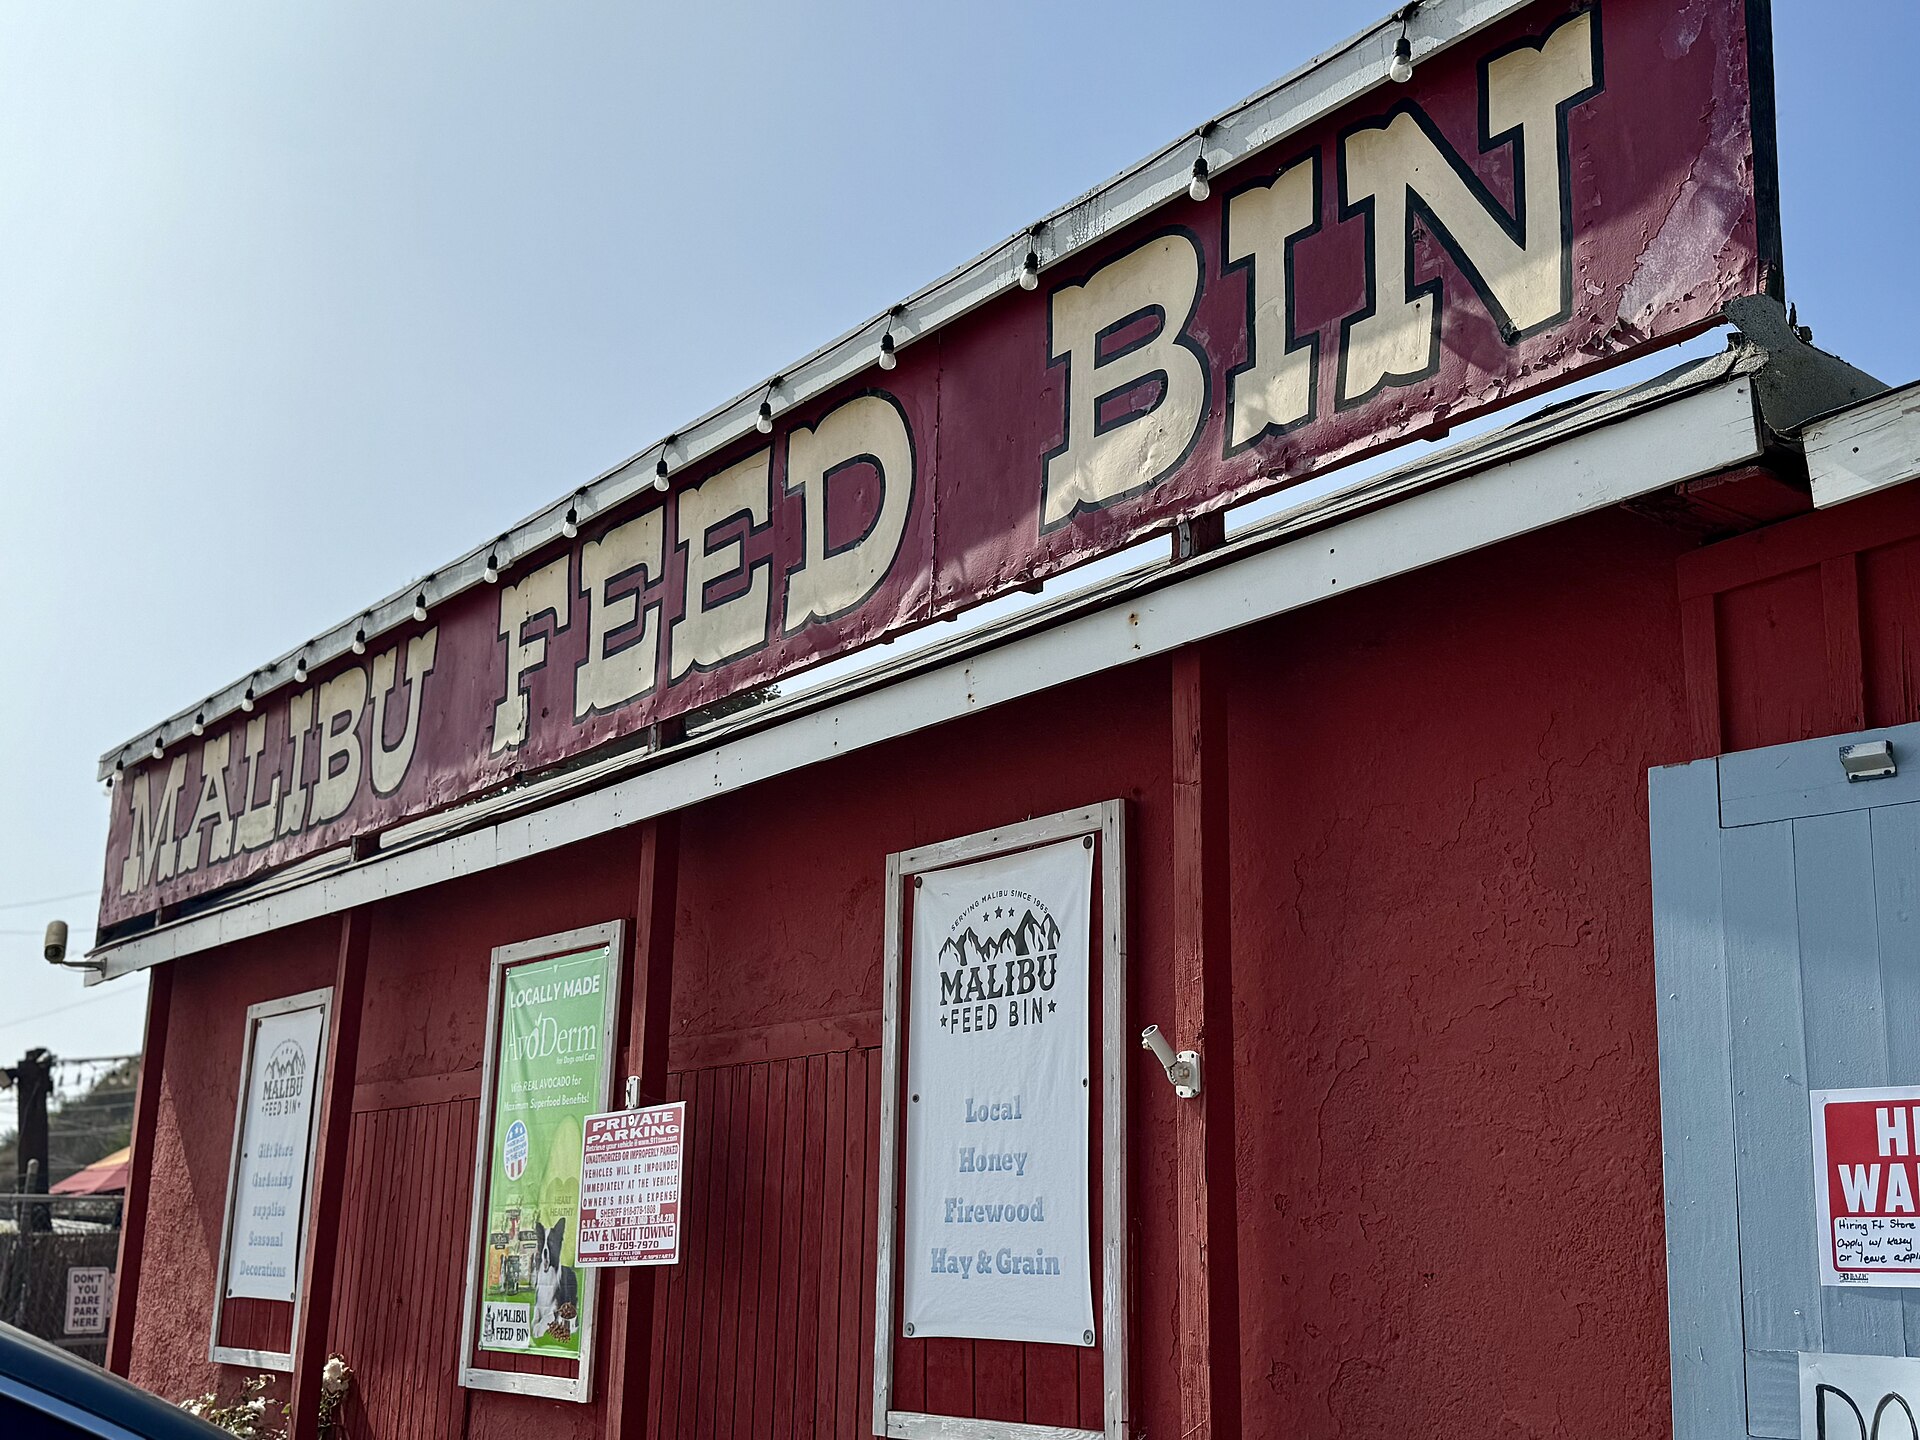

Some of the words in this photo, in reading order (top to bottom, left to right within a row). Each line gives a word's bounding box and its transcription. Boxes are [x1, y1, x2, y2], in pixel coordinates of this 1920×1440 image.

[120, 625, 439, 897] MALIBU
[490, 387, 916, 758] FEED
[1039, 3, 1604, 535] BIN
[951, 900, 980, 931] SERVING
[981, 890, 1008, 903] MALIBU
[1011, 889, 1032, 901] SINCE
[1033, 897, 1049, 914] 1965
[940, 953, 1057, 1006] MALIBU
[510, 981, 560, 1009] LOCALLY
[563, 974, 600, 999] MADE
[951, 1003, 997, 1034] FEED
[1009, 996, 1043, 1027] BIN
[262, 1076, 304, 1101] MALIBU
[522, 1079, 538, 1092] REAL
[540, 1075, 570, 1089] AVOCADO
[572, 1074, 581, 1085] for
[530, 1095, 560, 1111] Superfood
[562, 1091, 589, 1106] Benefits!
[965, 1095, 1022, 1123] Local
[586, 1125, 679, 1145] PARKING
[258, 1142, 272, 1158] Gift
[585, 1152, 621, 1165] UNAUTHORIZED
[622, 1151, 630, 1160] OR
[630, 1147, 659, 1160] IMPROPERLY
[660, 1145, 678, 1156] PARKED
[585, 1167, 613, 1179] VEHICLES
[617, 1165, 630, 1176] WILL
[634, 1164, 641, 1174] BE
[645, 1160, 677, 1173] IMPOUNDED
[959, 1147, 1028, 1176] Honey
[252, 1171, 293, 1189] Gardening
[584, 1180, 624, 1194] IMMEDIATELY
[628, 1179, 635, 1189] AT
[639, 1178, 649, 1188] THE
[653, 1175, 677, 1187] VEHICLE
[1837, 1162, 1920, 1213] WA
[554, 1195, 572, 1205] HEART
[583, 1196, 614, 1208] OWNER'S
[618, 1194, 634, 1205] RISK
[647, 1190, 677, 1202] EXPENSE
[549, 1207, 574, 1217] HEALTHY
[600, 1207, 622, 1218] SHERIFF
[944, 1196, 1044, 1223] Firewood
[582, 1230, 600, 1242] DAY
[602, 1229, 608, 1241] &
[610, 1227, 637, 1241] NIGHT
[640, 1225, 674, 1239] TOWING
[1839, 1217, 1868, 1236] Hiring
[1890, 1218, 1916, 1229] Store
[248, 1231, 283, 1247] Seasonal
[599, 1240, 659, 1251] 818-709-7970
[1869, 1237, 1882, 1248] w/
[240, 1260, 286, 1278] Decorations
[931, 1248, 972, 1279] Hay
[976, 1249, 992, 1274] &
[996, 1248, 1060, 1275] Grain
[73, 1274, 103, 1283] DON'T
[77, 1285, 98, 1294] YOU
[74, 1296, 100, 1305] DARE
[73, 1306, 99, 1316] PARK
[496, 1308, 527, 1323] MALIBU
[72, 1317, 98, 1327] HERE
[495, 1327, 514, 1341] FEED
[516, 1328, 529, 1341] BIN
